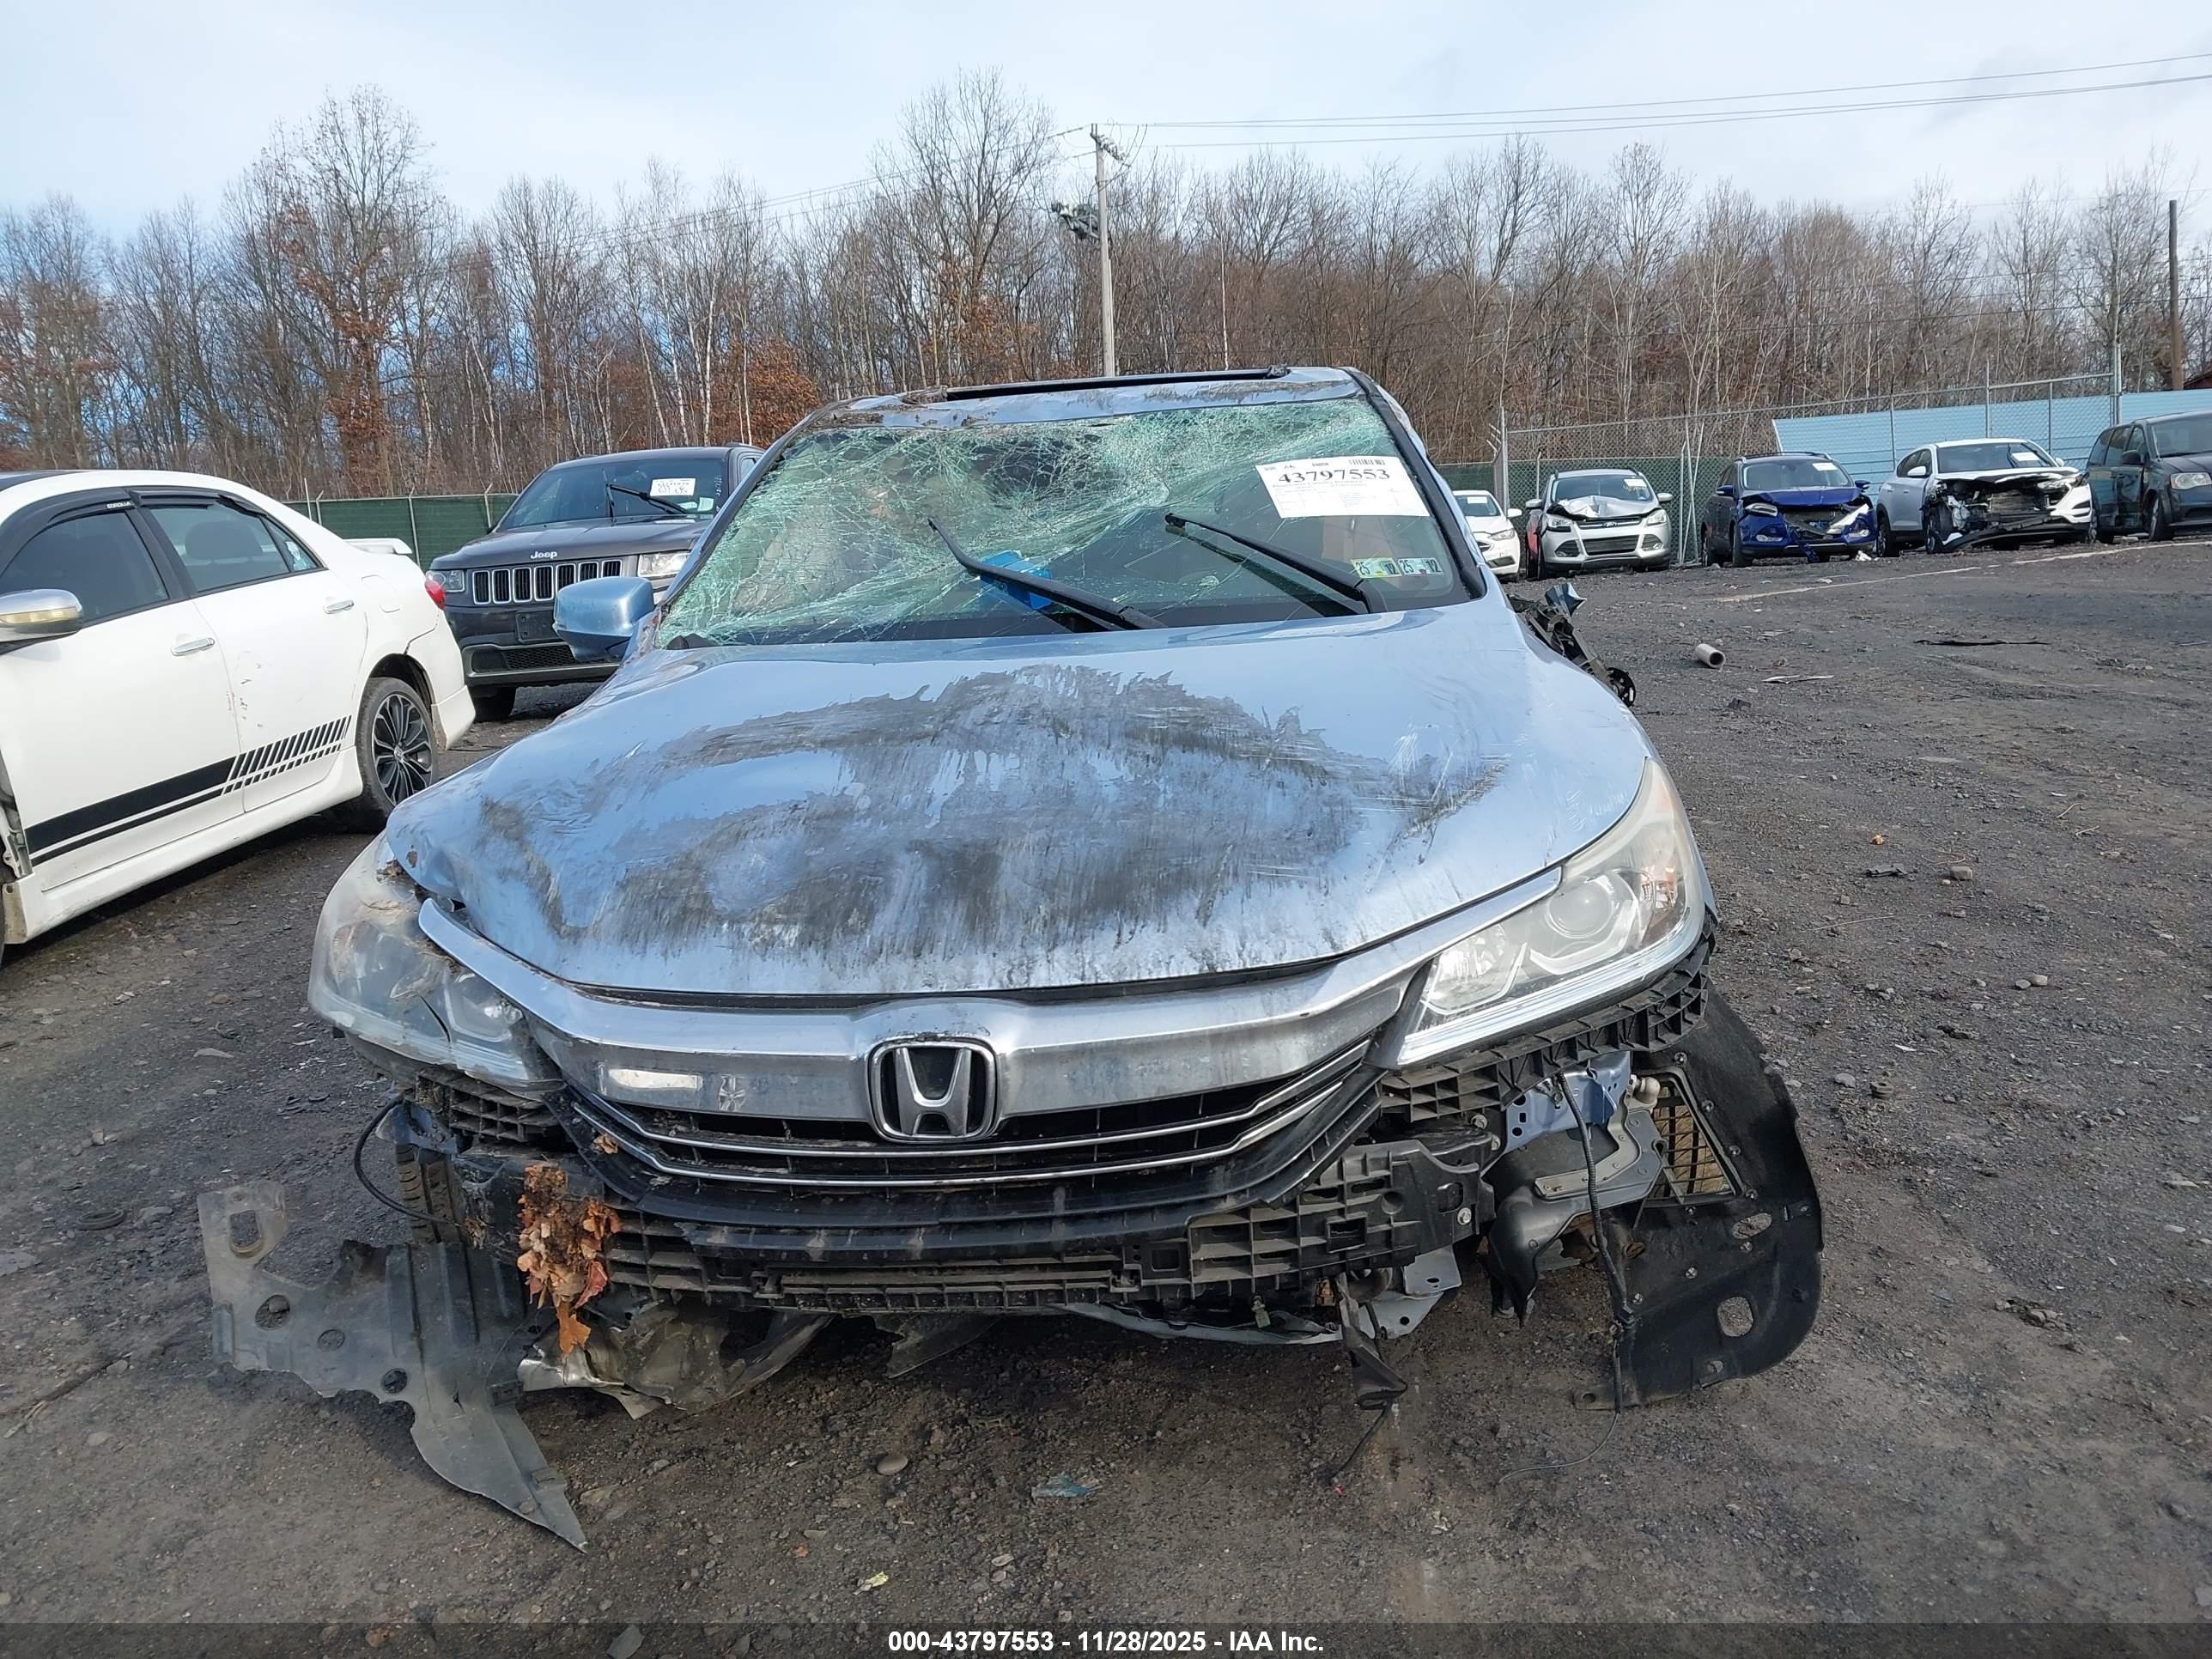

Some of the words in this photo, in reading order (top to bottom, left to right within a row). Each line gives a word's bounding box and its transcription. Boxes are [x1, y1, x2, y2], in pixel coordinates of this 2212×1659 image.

[1278, 469, 1390, 483] 43797553
[530, 550, 558, 559] Jeep
[1356, 562, 1370, 574] 25
[1384, 562, 1400, 574] 12
[1400, 559, 1414, 573] 25
[1425, 559, 1443, 573] 12
